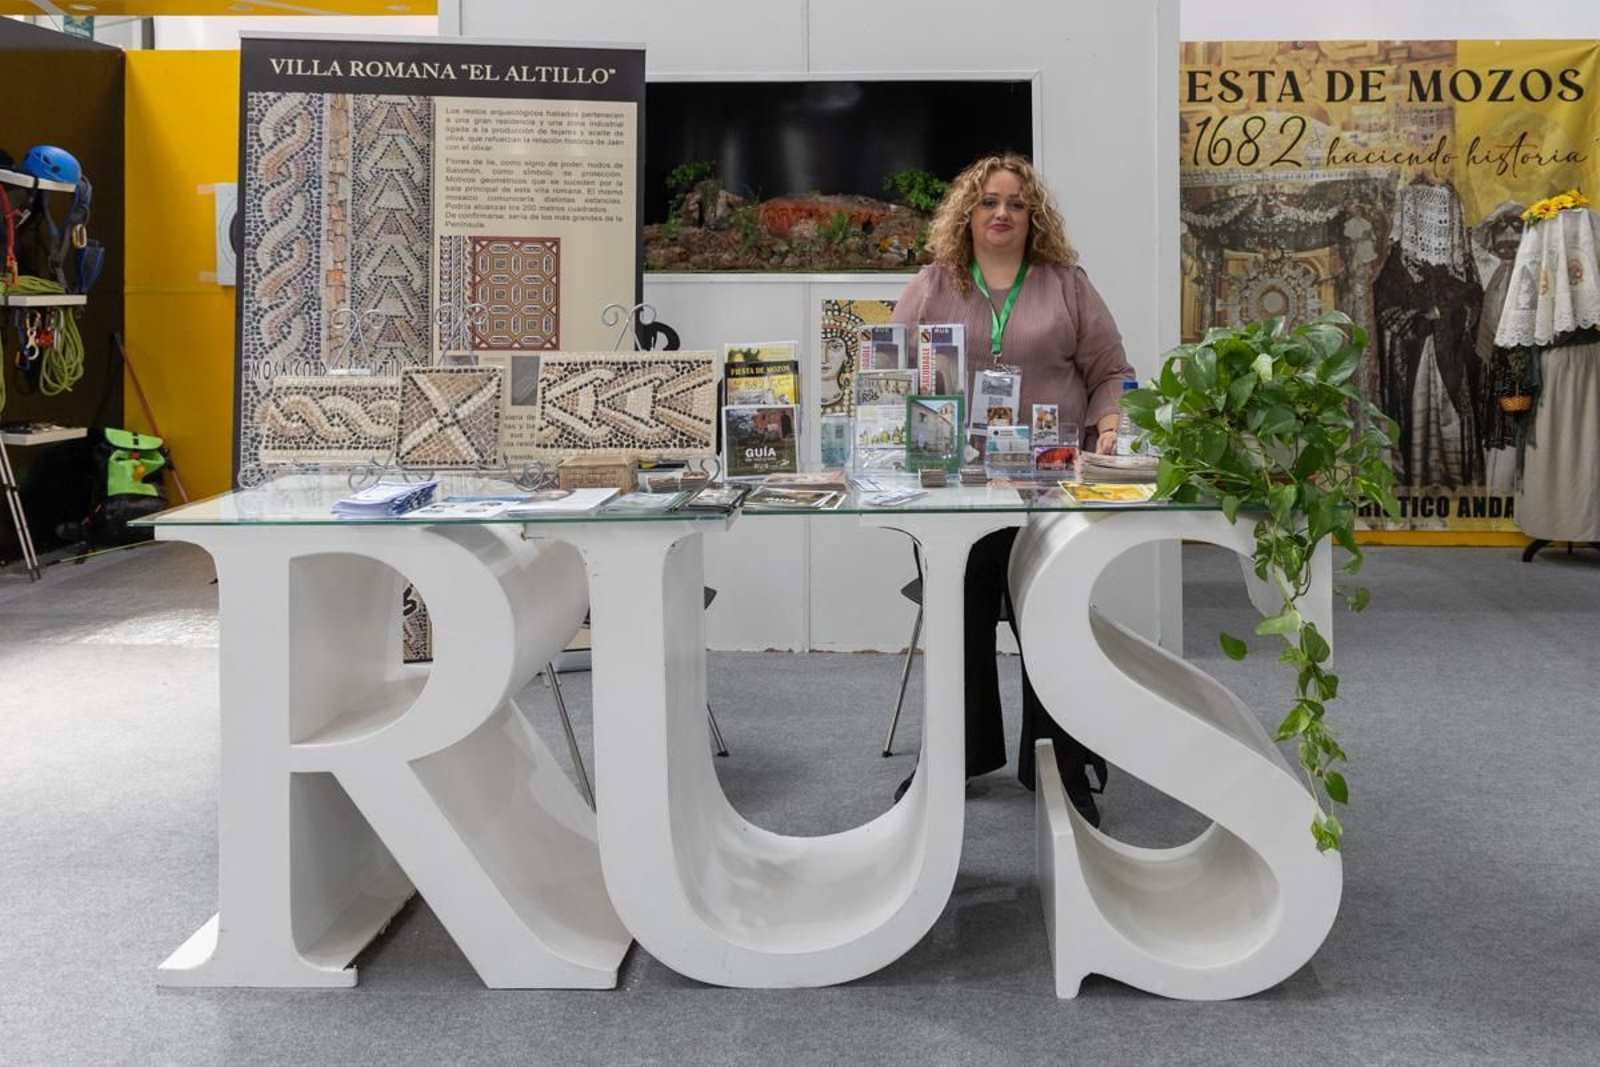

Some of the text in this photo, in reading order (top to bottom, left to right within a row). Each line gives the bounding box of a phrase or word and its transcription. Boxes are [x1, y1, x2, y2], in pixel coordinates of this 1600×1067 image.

[269, 58, 343, 76] VILLA
[349, 60, 457, 80] ROMANA
[1186, 68, 1585, 103] ESTA DE MOZOS
[1193, 114, 1589, 178] 1682 haciendo historia
[730, 367, 755, 375] FIESTA
[767, 364, 790, 373] MOZOS
[745, 445, 777, 458] GUÍA
[1457, 497, 1514, 518] ANDA
[155, 512, 1343, 1000] RUS
